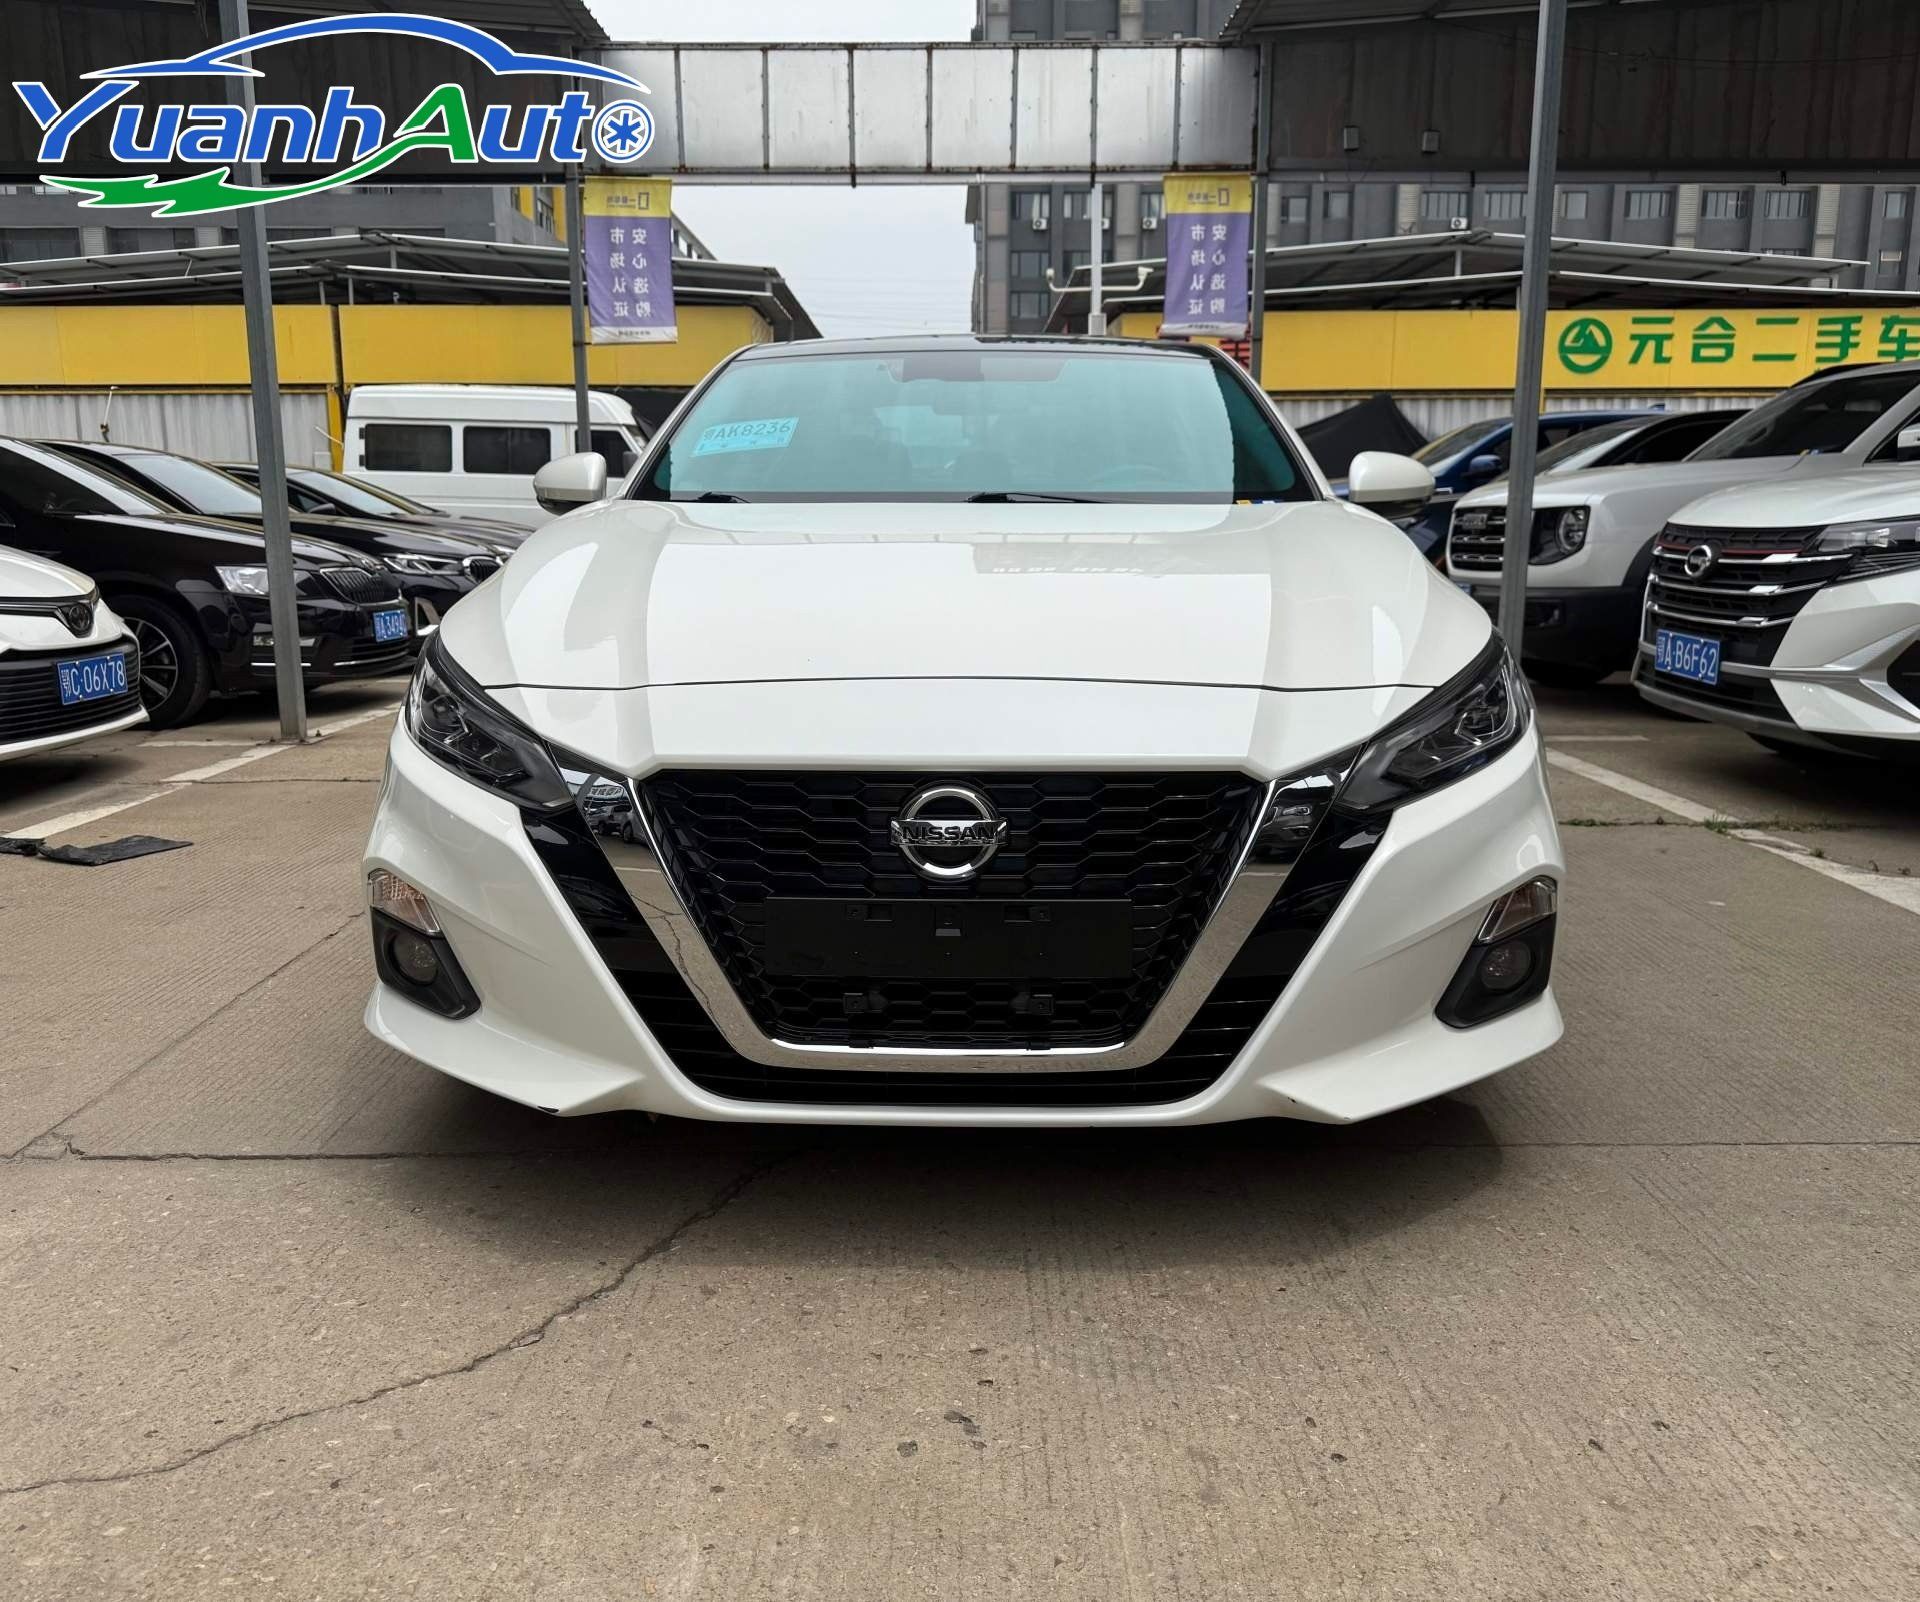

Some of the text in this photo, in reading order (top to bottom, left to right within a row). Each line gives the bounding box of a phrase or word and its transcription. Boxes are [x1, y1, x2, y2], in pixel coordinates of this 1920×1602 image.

[1628, 314, 1920, 365] 元合二手车
[902, 825, 996, 841] NISSAN
